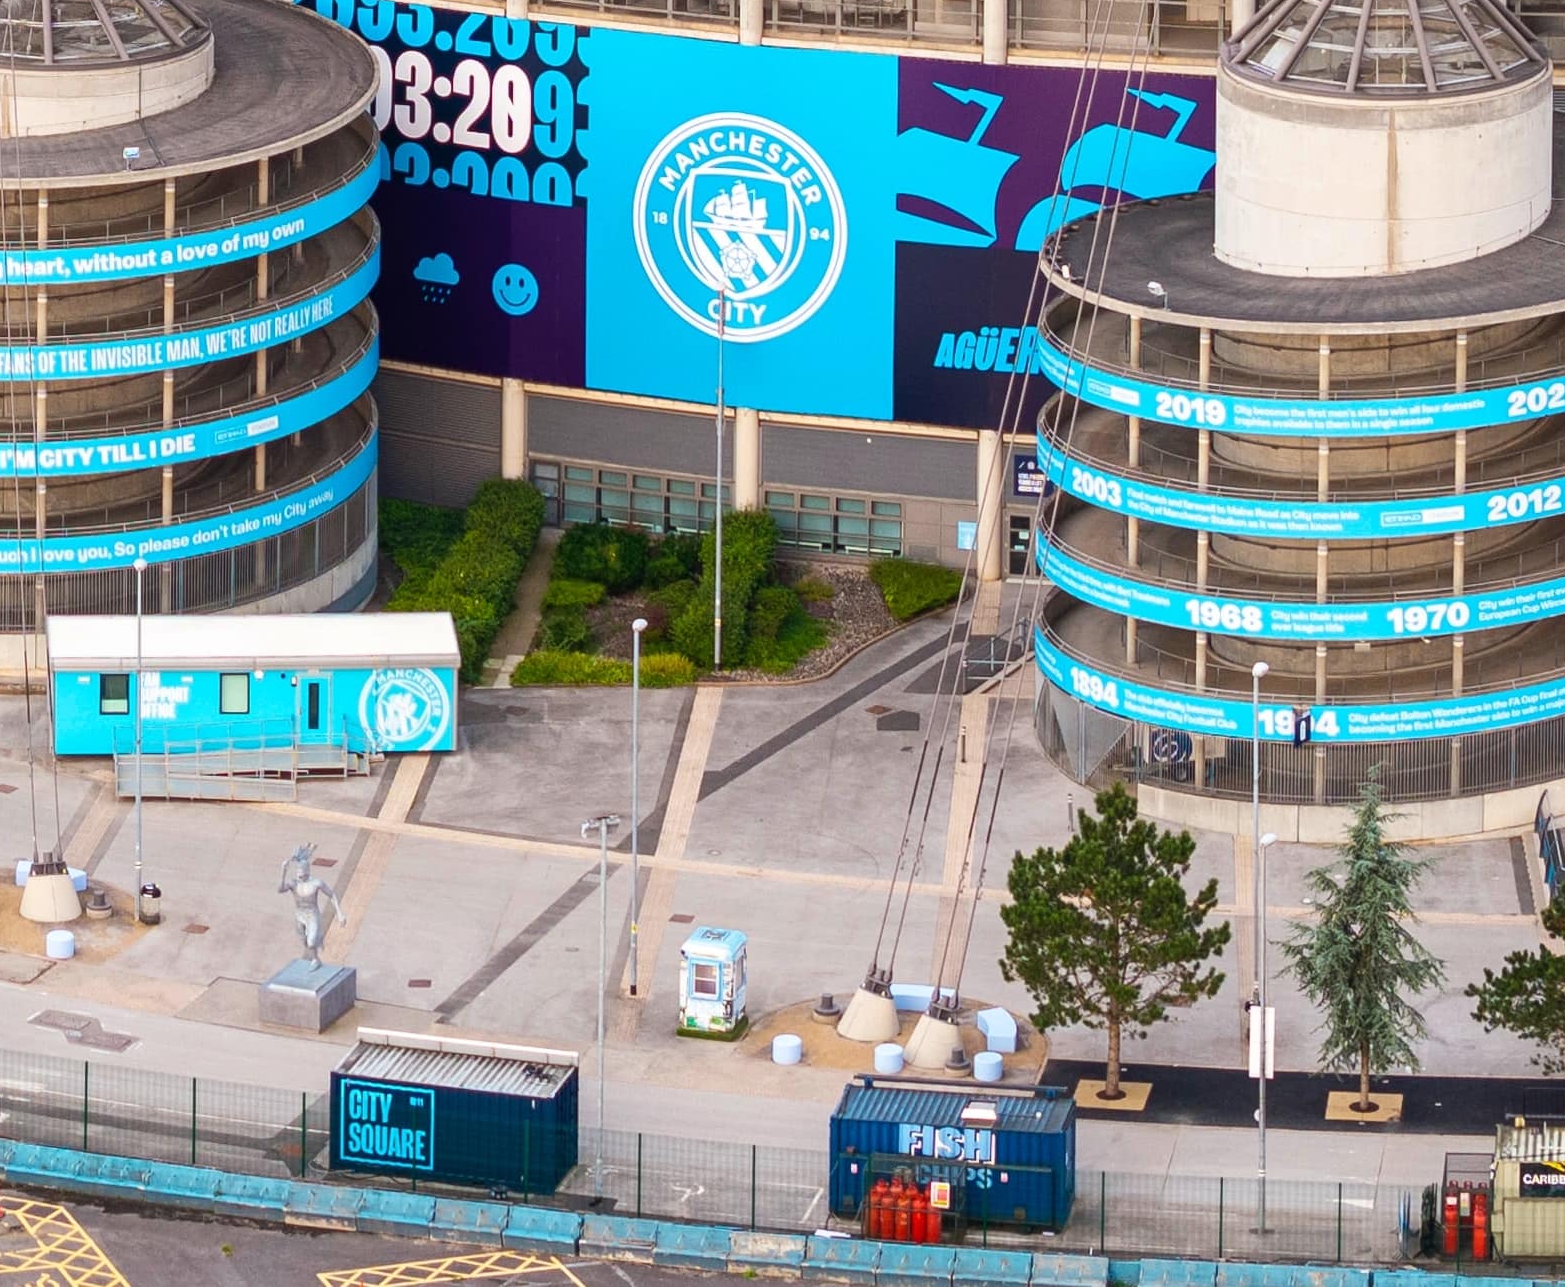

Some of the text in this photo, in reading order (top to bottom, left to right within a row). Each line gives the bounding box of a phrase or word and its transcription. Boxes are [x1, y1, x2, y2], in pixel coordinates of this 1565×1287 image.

[658, 131, 824, 208] MANCHESTER
[652, 211, 669, 224] 18
[808, 228, 831, 242] 94
[8, 256, 71, 278] heart,
[74, 249, 156, 273] without
[160, 251, 173, 265] a
[177, 244, 218, 262] love
[221, 235, 240, 254] of
[243, 232, 270, 250] my
[272, 218, 305, 240] own
[707, 299, 767, 327] CITY
[37, 351, 59, 372] OF
[60, 349, 86, 371] THE
[91, 342, 163, 368] INVISIBLE
[167, 337, 205, 362] MAN,
[206, 328, 247, 353] WE'RE
[250, 322, 273, 343] NOT
[274, 310, 310, 337] REALLY
[311, 294, 334, 321] HERE
[1155, 391, 1226, 425] 2019
[0, 449, 35, 469] I'M
[39, 446, 94, 468] CITY
[96, 440, 143, 465] TILL
[150, 439, 156, 458] I
[160, 433, 196, 455] DIE
[1072, 467, 1122, 507] 2003
[1486, 485, 1562, 521] 2012
[78, 542, 112, 563] you,
[114, 541, 135, 557] So
[138, 536, 188, 557] please
[192, 525, 229, 545] don't
[231, 517, 260, 535] take
[262, 512, 282, 529] my
[284, 499, 307, 522] City
[308, 489, 334, 510] away
[1186, 599, 1263, 632] 1968
[1386, 601, 1470, 633] 1970
[1070, 666, 1119, 708] 1894
[1258, 709, 1341, 737] 194
[349, 1089, 392, 1123] CITY
[348, 1123, 426, 1160] SQUARE
[899, 1124, 996, 1164] FISH
